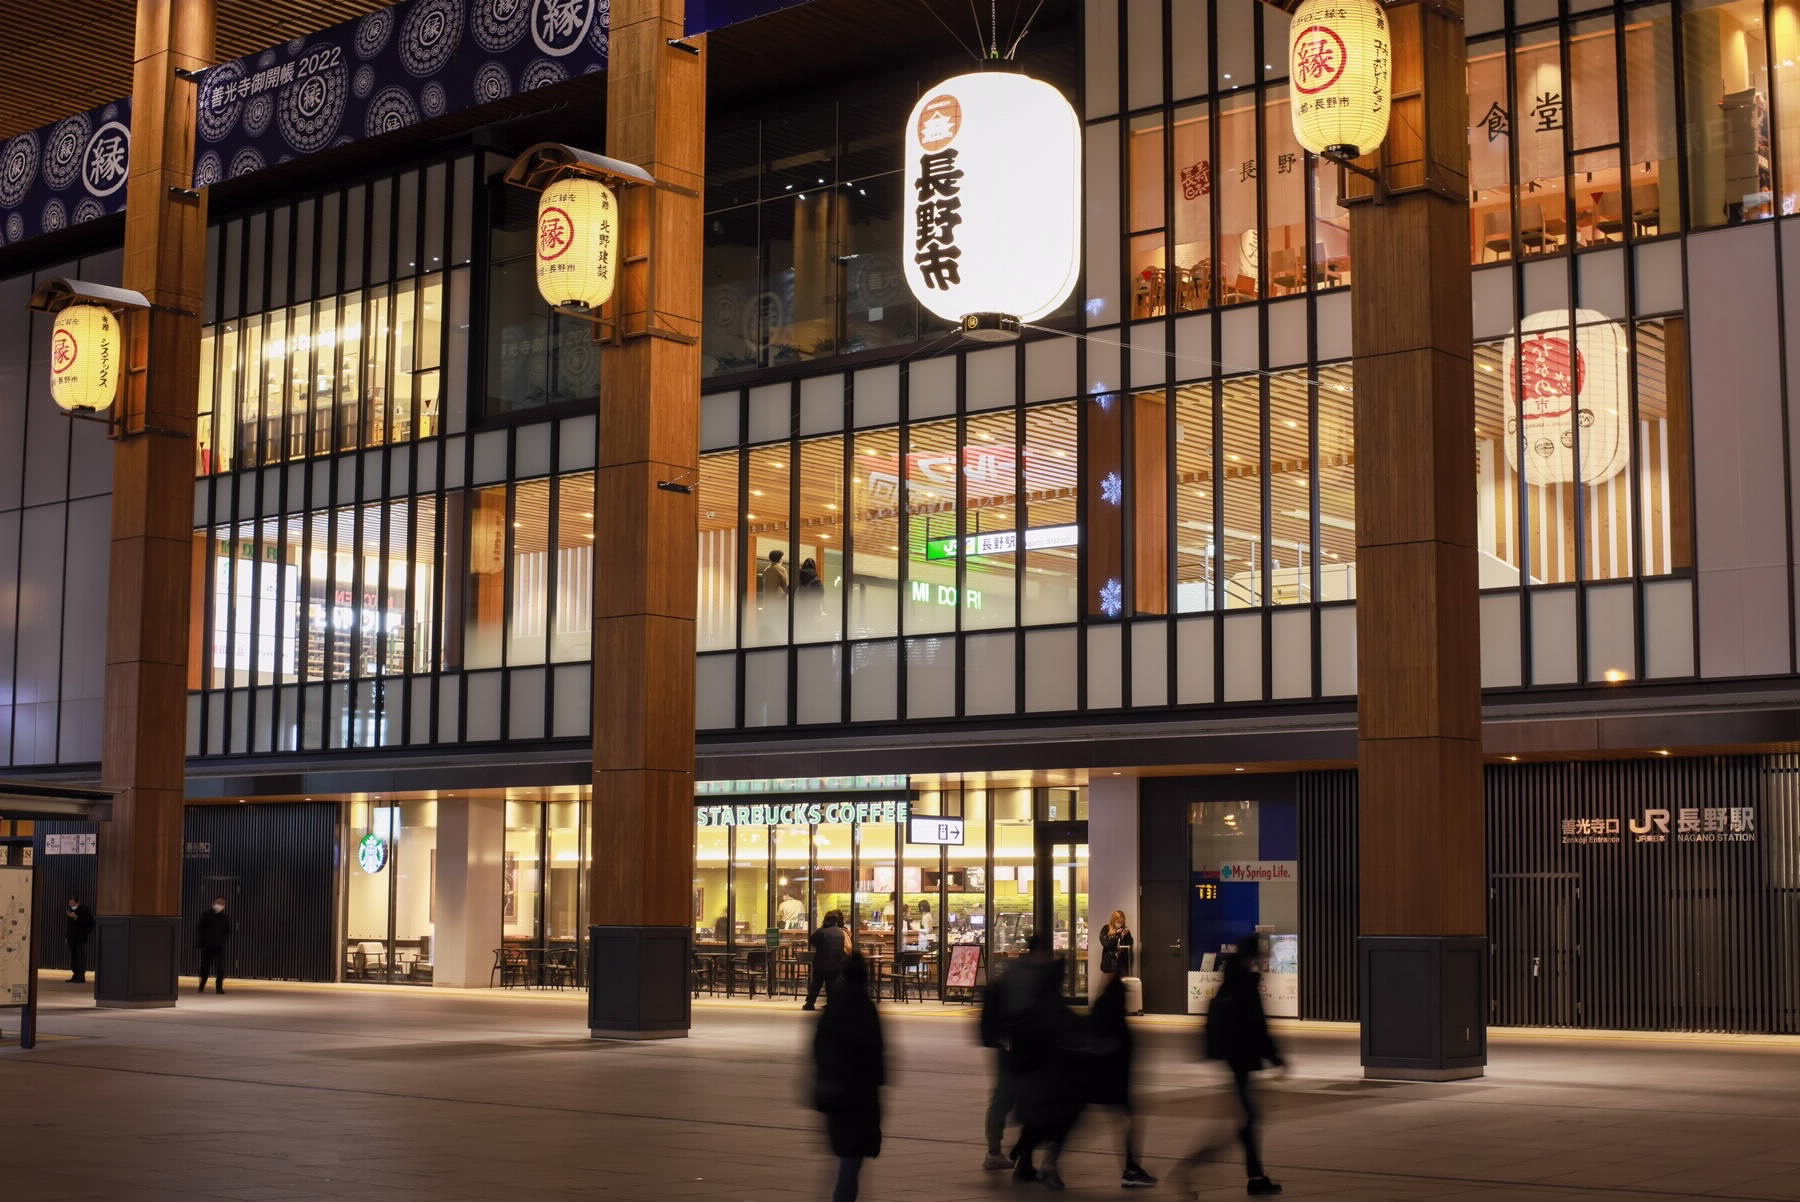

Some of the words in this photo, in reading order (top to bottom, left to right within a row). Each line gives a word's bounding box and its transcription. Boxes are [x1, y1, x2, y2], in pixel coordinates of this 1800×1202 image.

[1298, 39, 1335, 84] 縁
[211, 61, 296, 109] 善光寺御開帳
[297, 46, 342, 79] 2022
[1476, 91, 1563, 142] 食堂
[90, 136, 125, 185] 縁
[914, 148, 965, 291] 長野市
[597, 220, 610, 280] 北野建設
[697, 804, 822, 826] STARBUCKS
[827, 802, 908, 824] COFFEE
[1562, 818, 1620, 835] 善光寺口
[1629, 809, 1670, 834] JR
[1677, 807, 1755, 833] 長野駅
[1562, 836, 1588, 846] Zenkoji
[1589, 836, 1620, 844] Entrance
[1635, 835, 1666, 843] JR東日本
[1677, 834, 1715, 842] NAGANO
[1717, 833, 1755, 842] STATION
[1233, 865, 1246, 880] My
[1246, 865, 1272, 881] Spring
[1273, 864, 1291, 878] Life.
